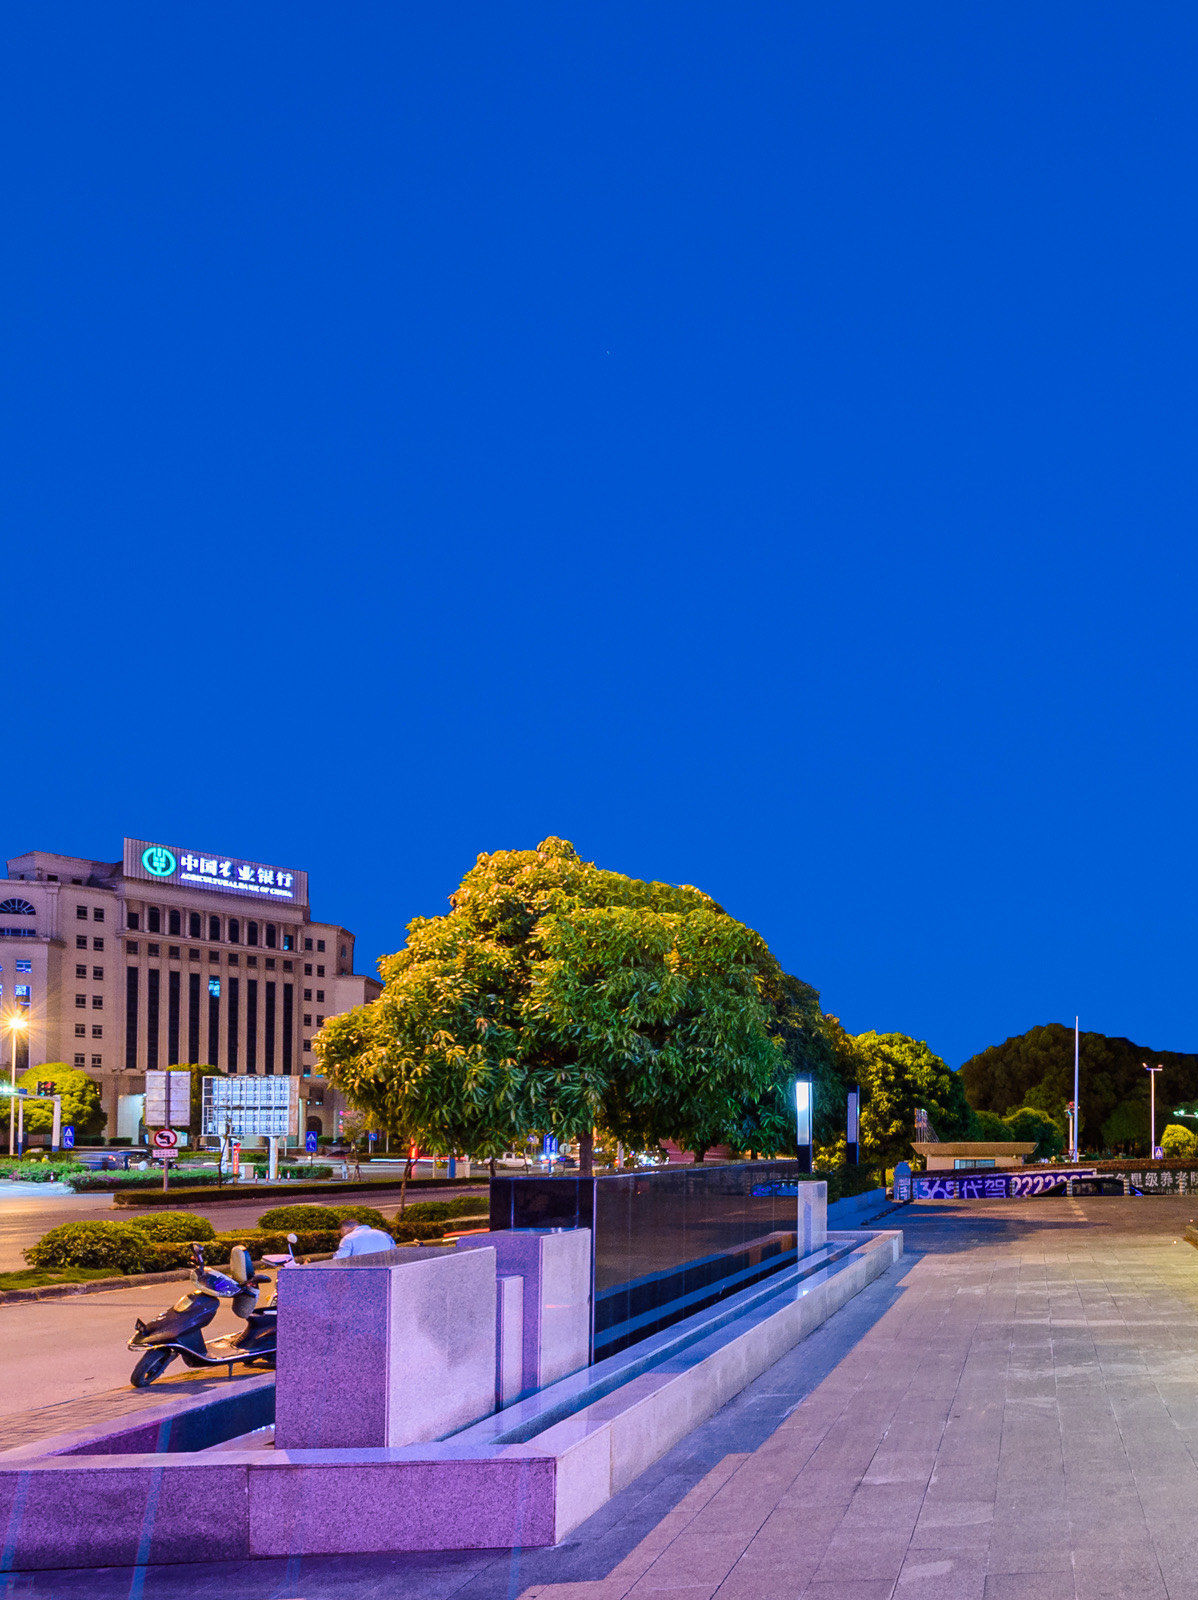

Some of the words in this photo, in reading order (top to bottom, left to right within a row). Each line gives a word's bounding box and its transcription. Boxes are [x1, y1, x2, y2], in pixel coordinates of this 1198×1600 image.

[180, 854, 294, 888] 中国农业银行
